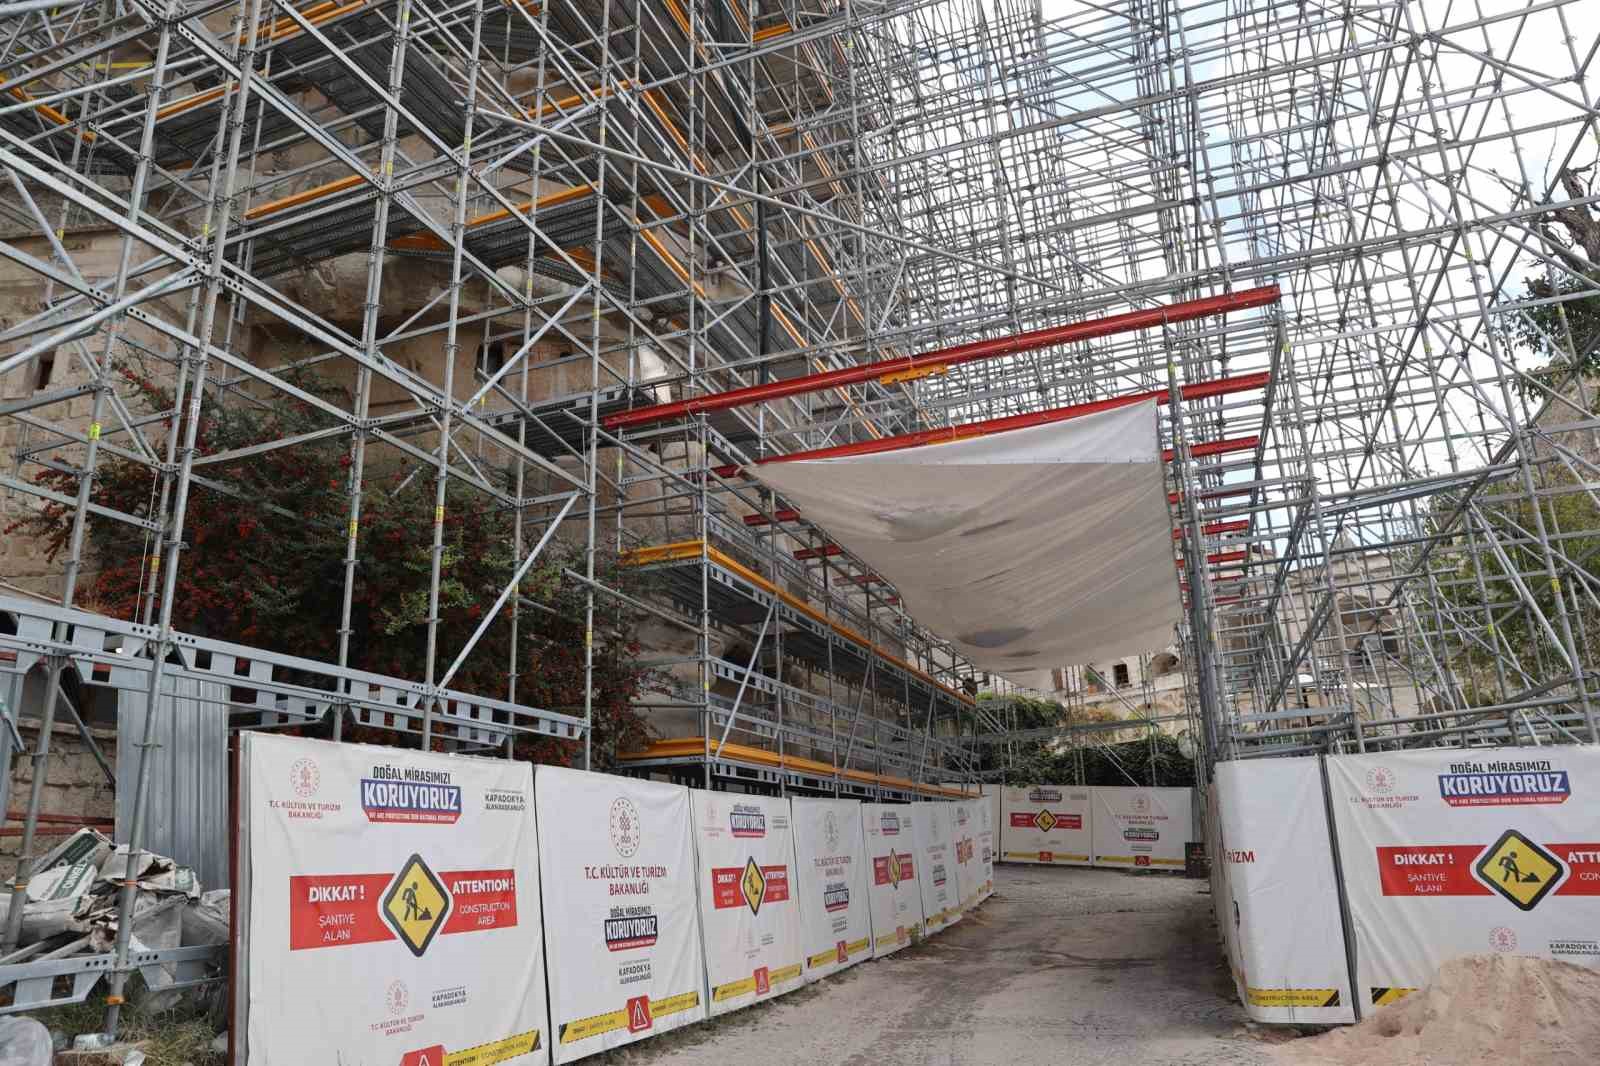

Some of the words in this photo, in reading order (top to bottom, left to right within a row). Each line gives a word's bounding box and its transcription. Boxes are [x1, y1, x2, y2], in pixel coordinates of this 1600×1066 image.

[373, 764, 402, 780] DOĞAL
[404, 767, 451, 785] MİRASIMIZI
[1450, 761, 1486, 774] DOĞAL
[1488, 760, 1551, 772] MİRASIMIZI
[1442, 773, 1565, 795] KORUYORUZ
[364, 782, 459, 810] KORUYORUZ
[1394, 853, 1445, 865] DİKKAT
[585, 866, 599, 880] T.C.
[600, 864, 630, 879] KÜLTÜR
[631, 866, 640, 878] VE
[642, 864, 667, 878] TURİZM
[453, 878, 510, 895] ATTENTION
[609, 880, 649, 896] BAKANLIĞI
[605, 918, 657, 940] KORUYORUZ
